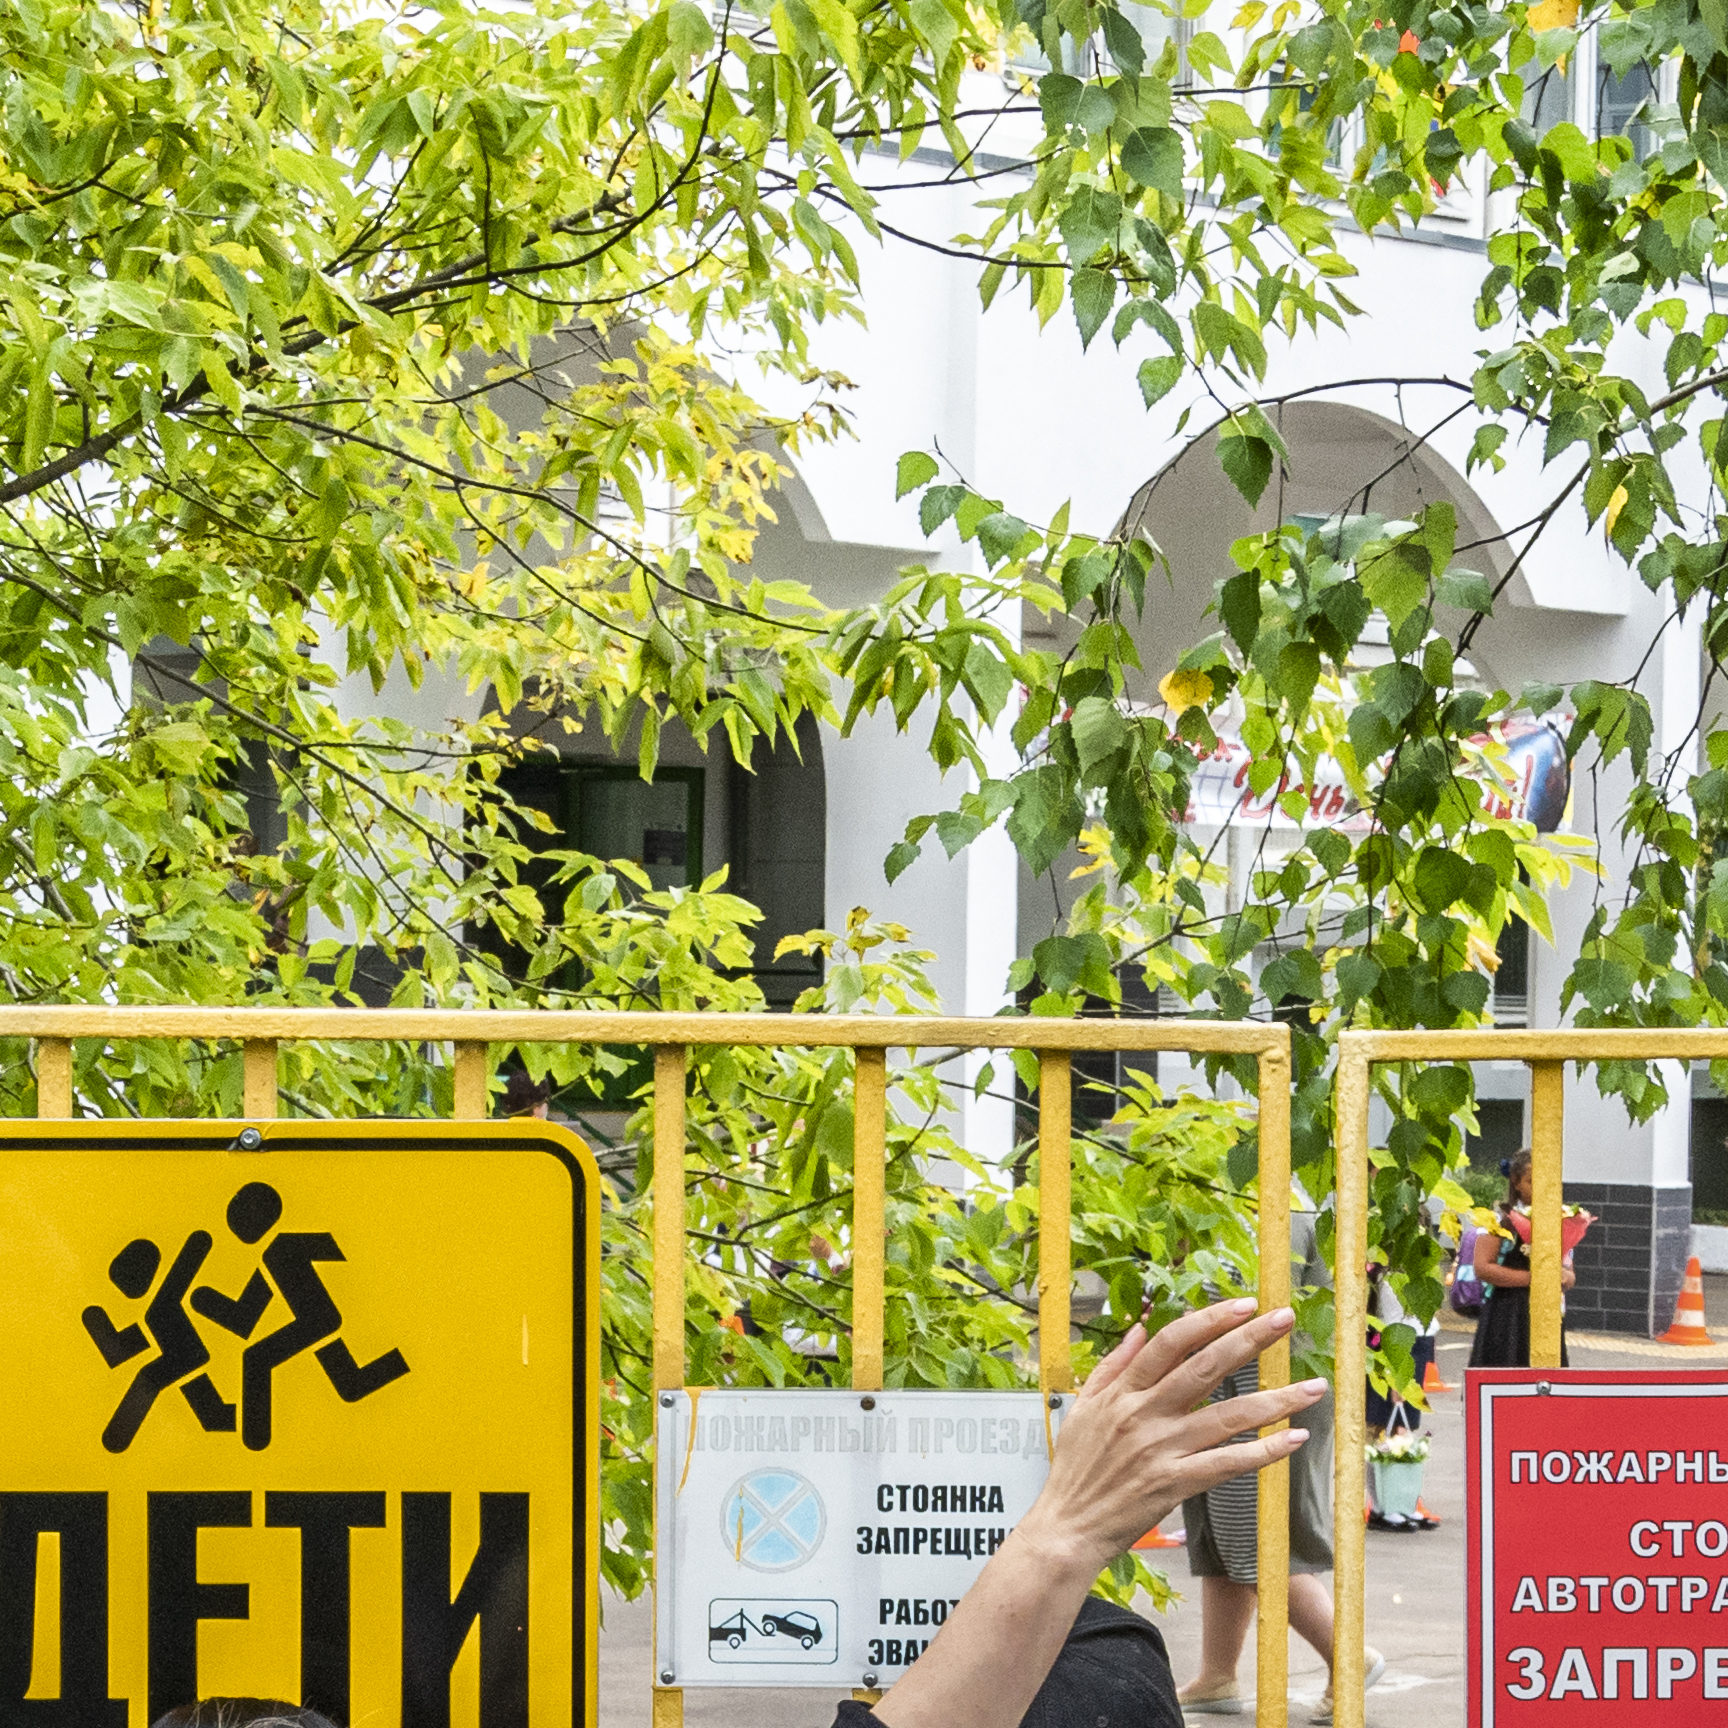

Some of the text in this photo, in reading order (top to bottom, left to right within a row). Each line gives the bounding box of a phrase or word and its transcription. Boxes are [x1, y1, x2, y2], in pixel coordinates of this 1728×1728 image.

[683, 1409, 897, 1453] ПОЖАРНЫЙ
[876, 1484, 1005, 1513] СТОЯНКА
[856, 1526, 1015, 1560] ЗАПРЕЩЕН
